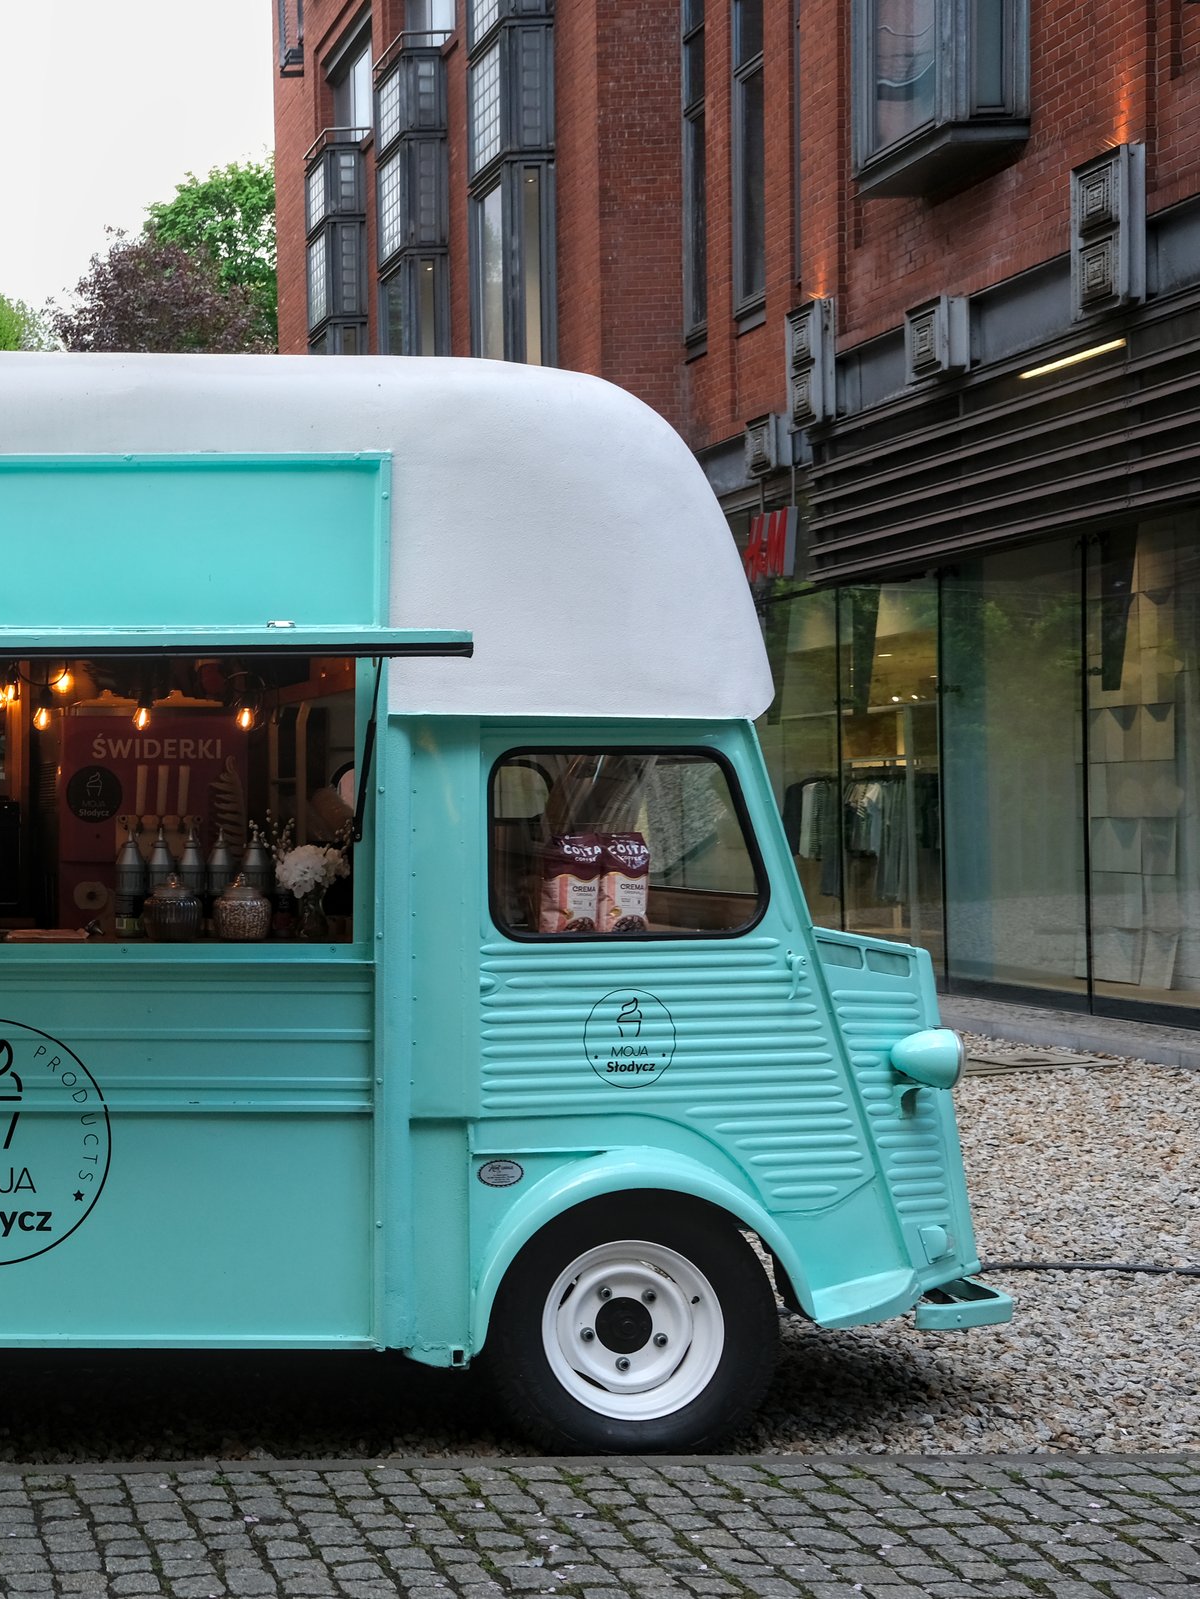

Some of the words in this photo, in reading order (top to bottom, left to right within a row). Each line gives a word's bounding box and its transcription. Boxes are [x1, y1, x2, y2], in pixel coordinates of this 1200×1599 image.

[92, 733, 222, 760] ŚWIDERKI
[79, 808, 110, 818] Słodycz
[563, 844, 602, 857] COSTA
[607, 843, 649, 855] COSTA
[611, 1045, 649, 1058] MOJA
[606, 1060, 656, 1075] Słodycz
[33, 1045, 99, 1183] PRODUCTS
